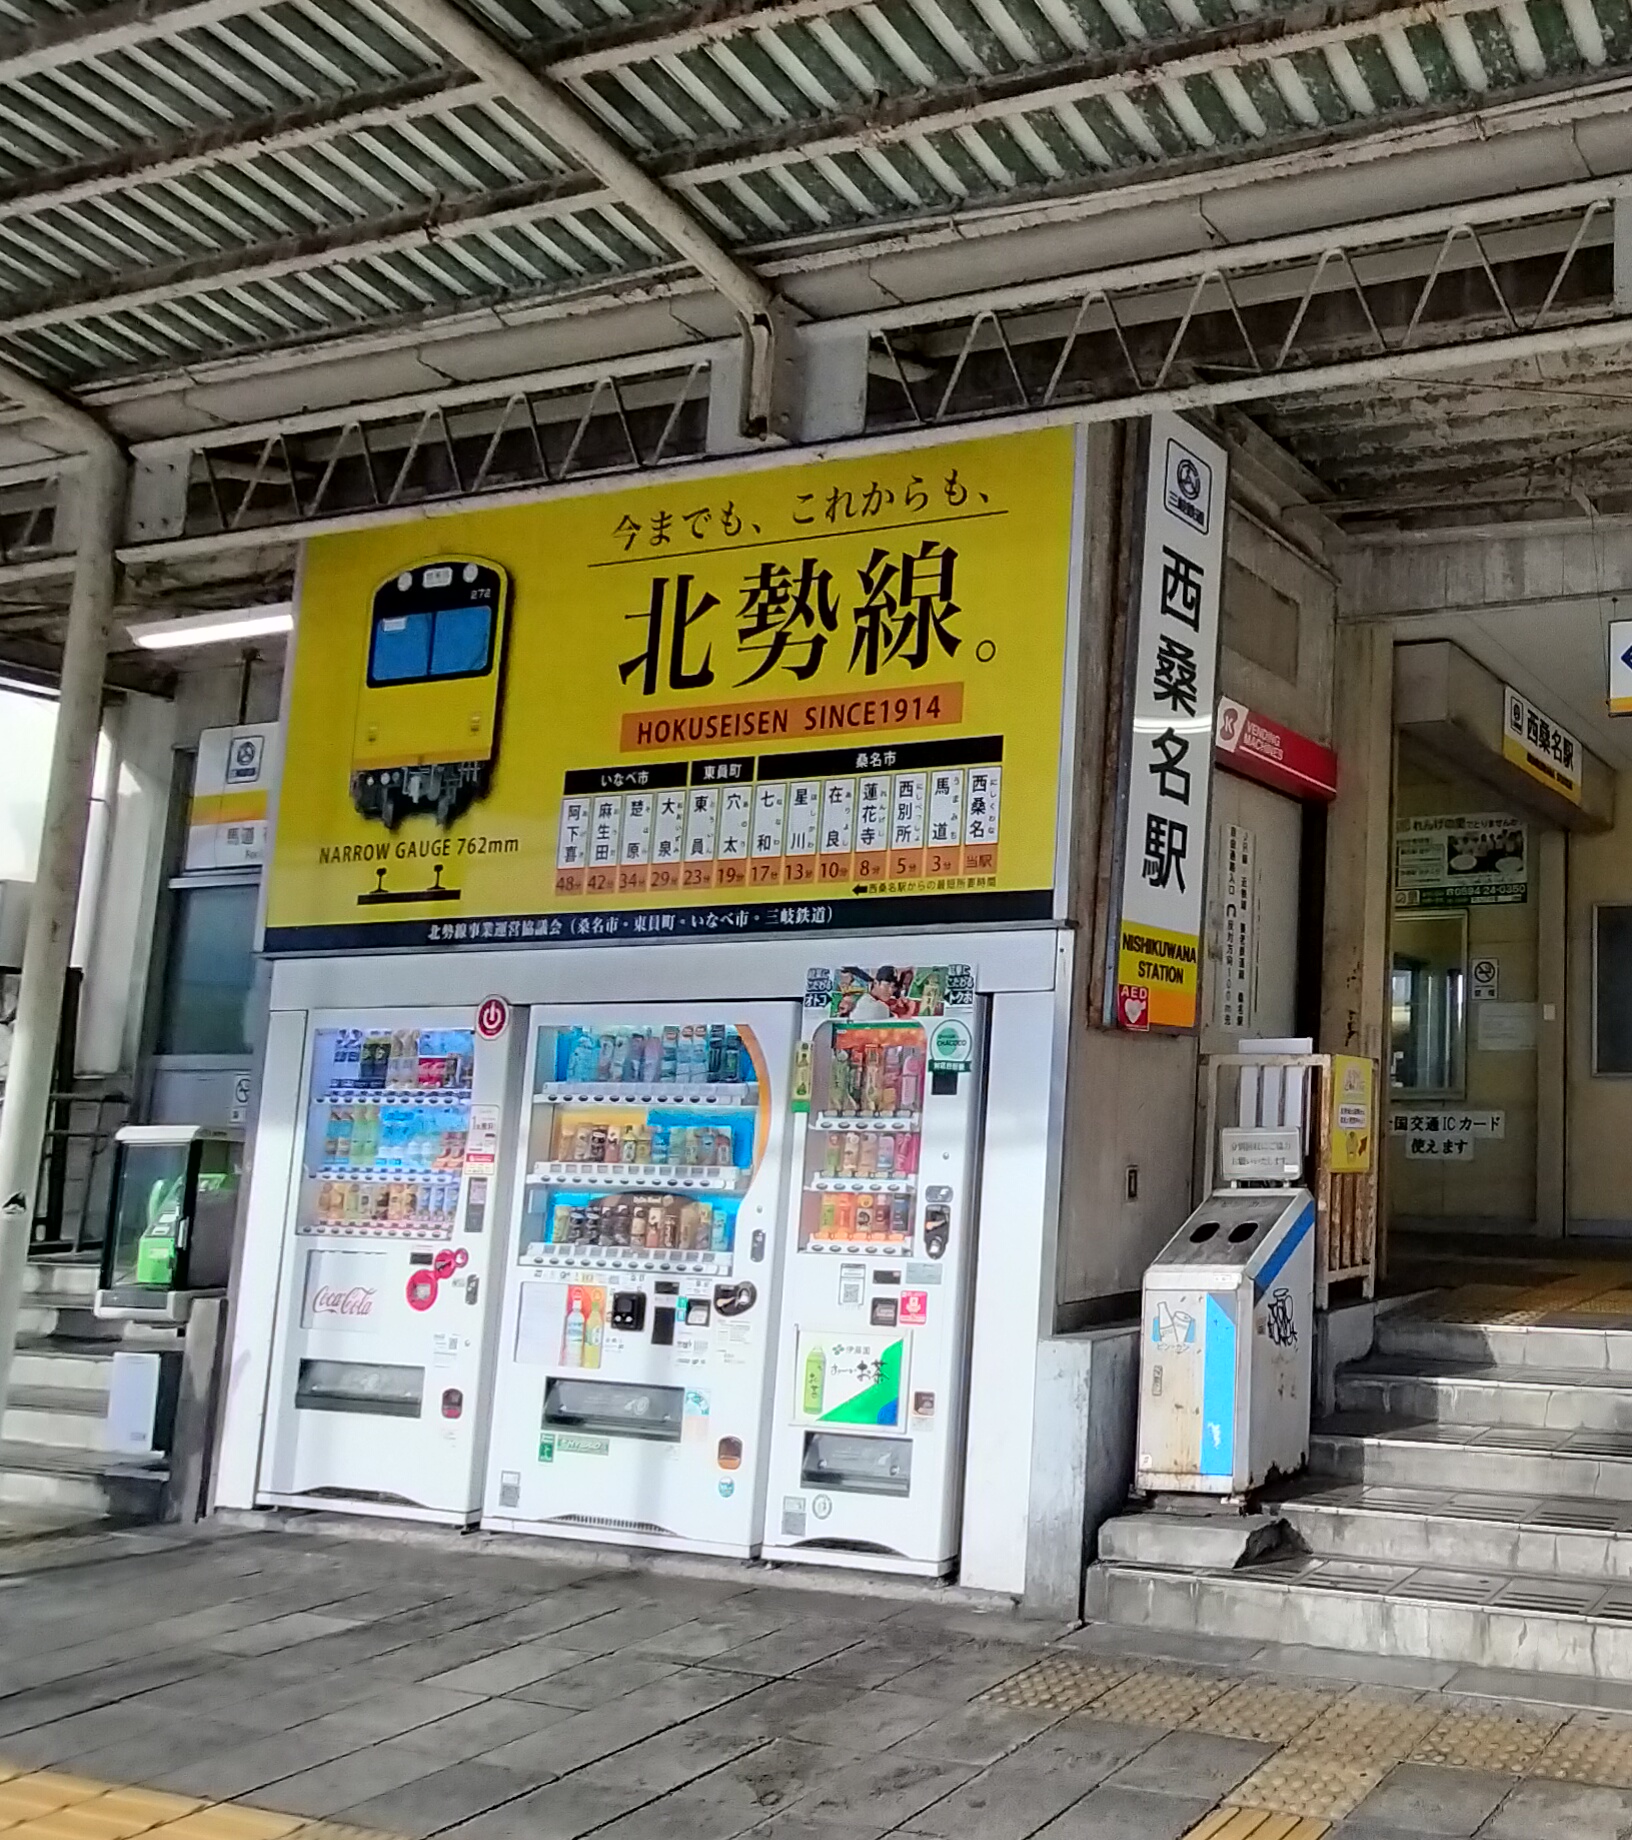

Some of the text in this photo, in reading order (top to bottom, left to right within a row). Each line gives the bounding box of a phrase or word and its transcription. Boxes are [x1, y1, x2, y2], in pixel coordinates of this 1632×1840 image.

[611, 468, 991, 552] 今までも、 これからも、
[636, 694, 942, 746] HOKUSEISEN SINCE1914
[1142, 544, 1205, 895] 西桑名駅
[1246, 720, 1282, 748] VENDING
[1527, 708, 1575, 773] 西桑名駅
[703, 763, 743, 781] 東員町
[855, 750, 898, 769] 桑名市
[1242, 733, 1285, 762] MACHINES
[601, 771, 651, 788] いなべ市
[969, 774, 989, 840] 西桑名
[564, 804, 582, 863] 阿下喜
[594, 802, 614, 862] 麻生田
[626, 800, 645, 860] 楚原
[657, 797, 676, 858] 大泉
[690, 795, 709, 857] 東員
[722, 793, 742, 854] 穴太
[756, 790, 776, 852] 七和
[790, 787, 809, 850] 星川
[825, 785, 844, 848] 在良
[859, 782, 879, 846] 蓮花寺
[894, 780, 915, 844] 西別所
[931, 777, 951, 842] 馬道
[319, 836, 520, 864] NARROW GAUGE 762mm
[965, 854, 994, 870] 当駅
[867, 876, 997, 895] 西桑名駅からの最短所要時間
[1121, 932, 1197, 964] NISHIKUWANA
[1137, 960, 1184, 985] STATION
[804, 993, 828, 1008] オトコ
[949, 991, 973, 1005] トクホ
[1120, 985, 1148, 1000] AED
[1389, 1115, 1501, 1132] 国交通ICカード
[1410, 1138, 1469, 1155] 使えます
